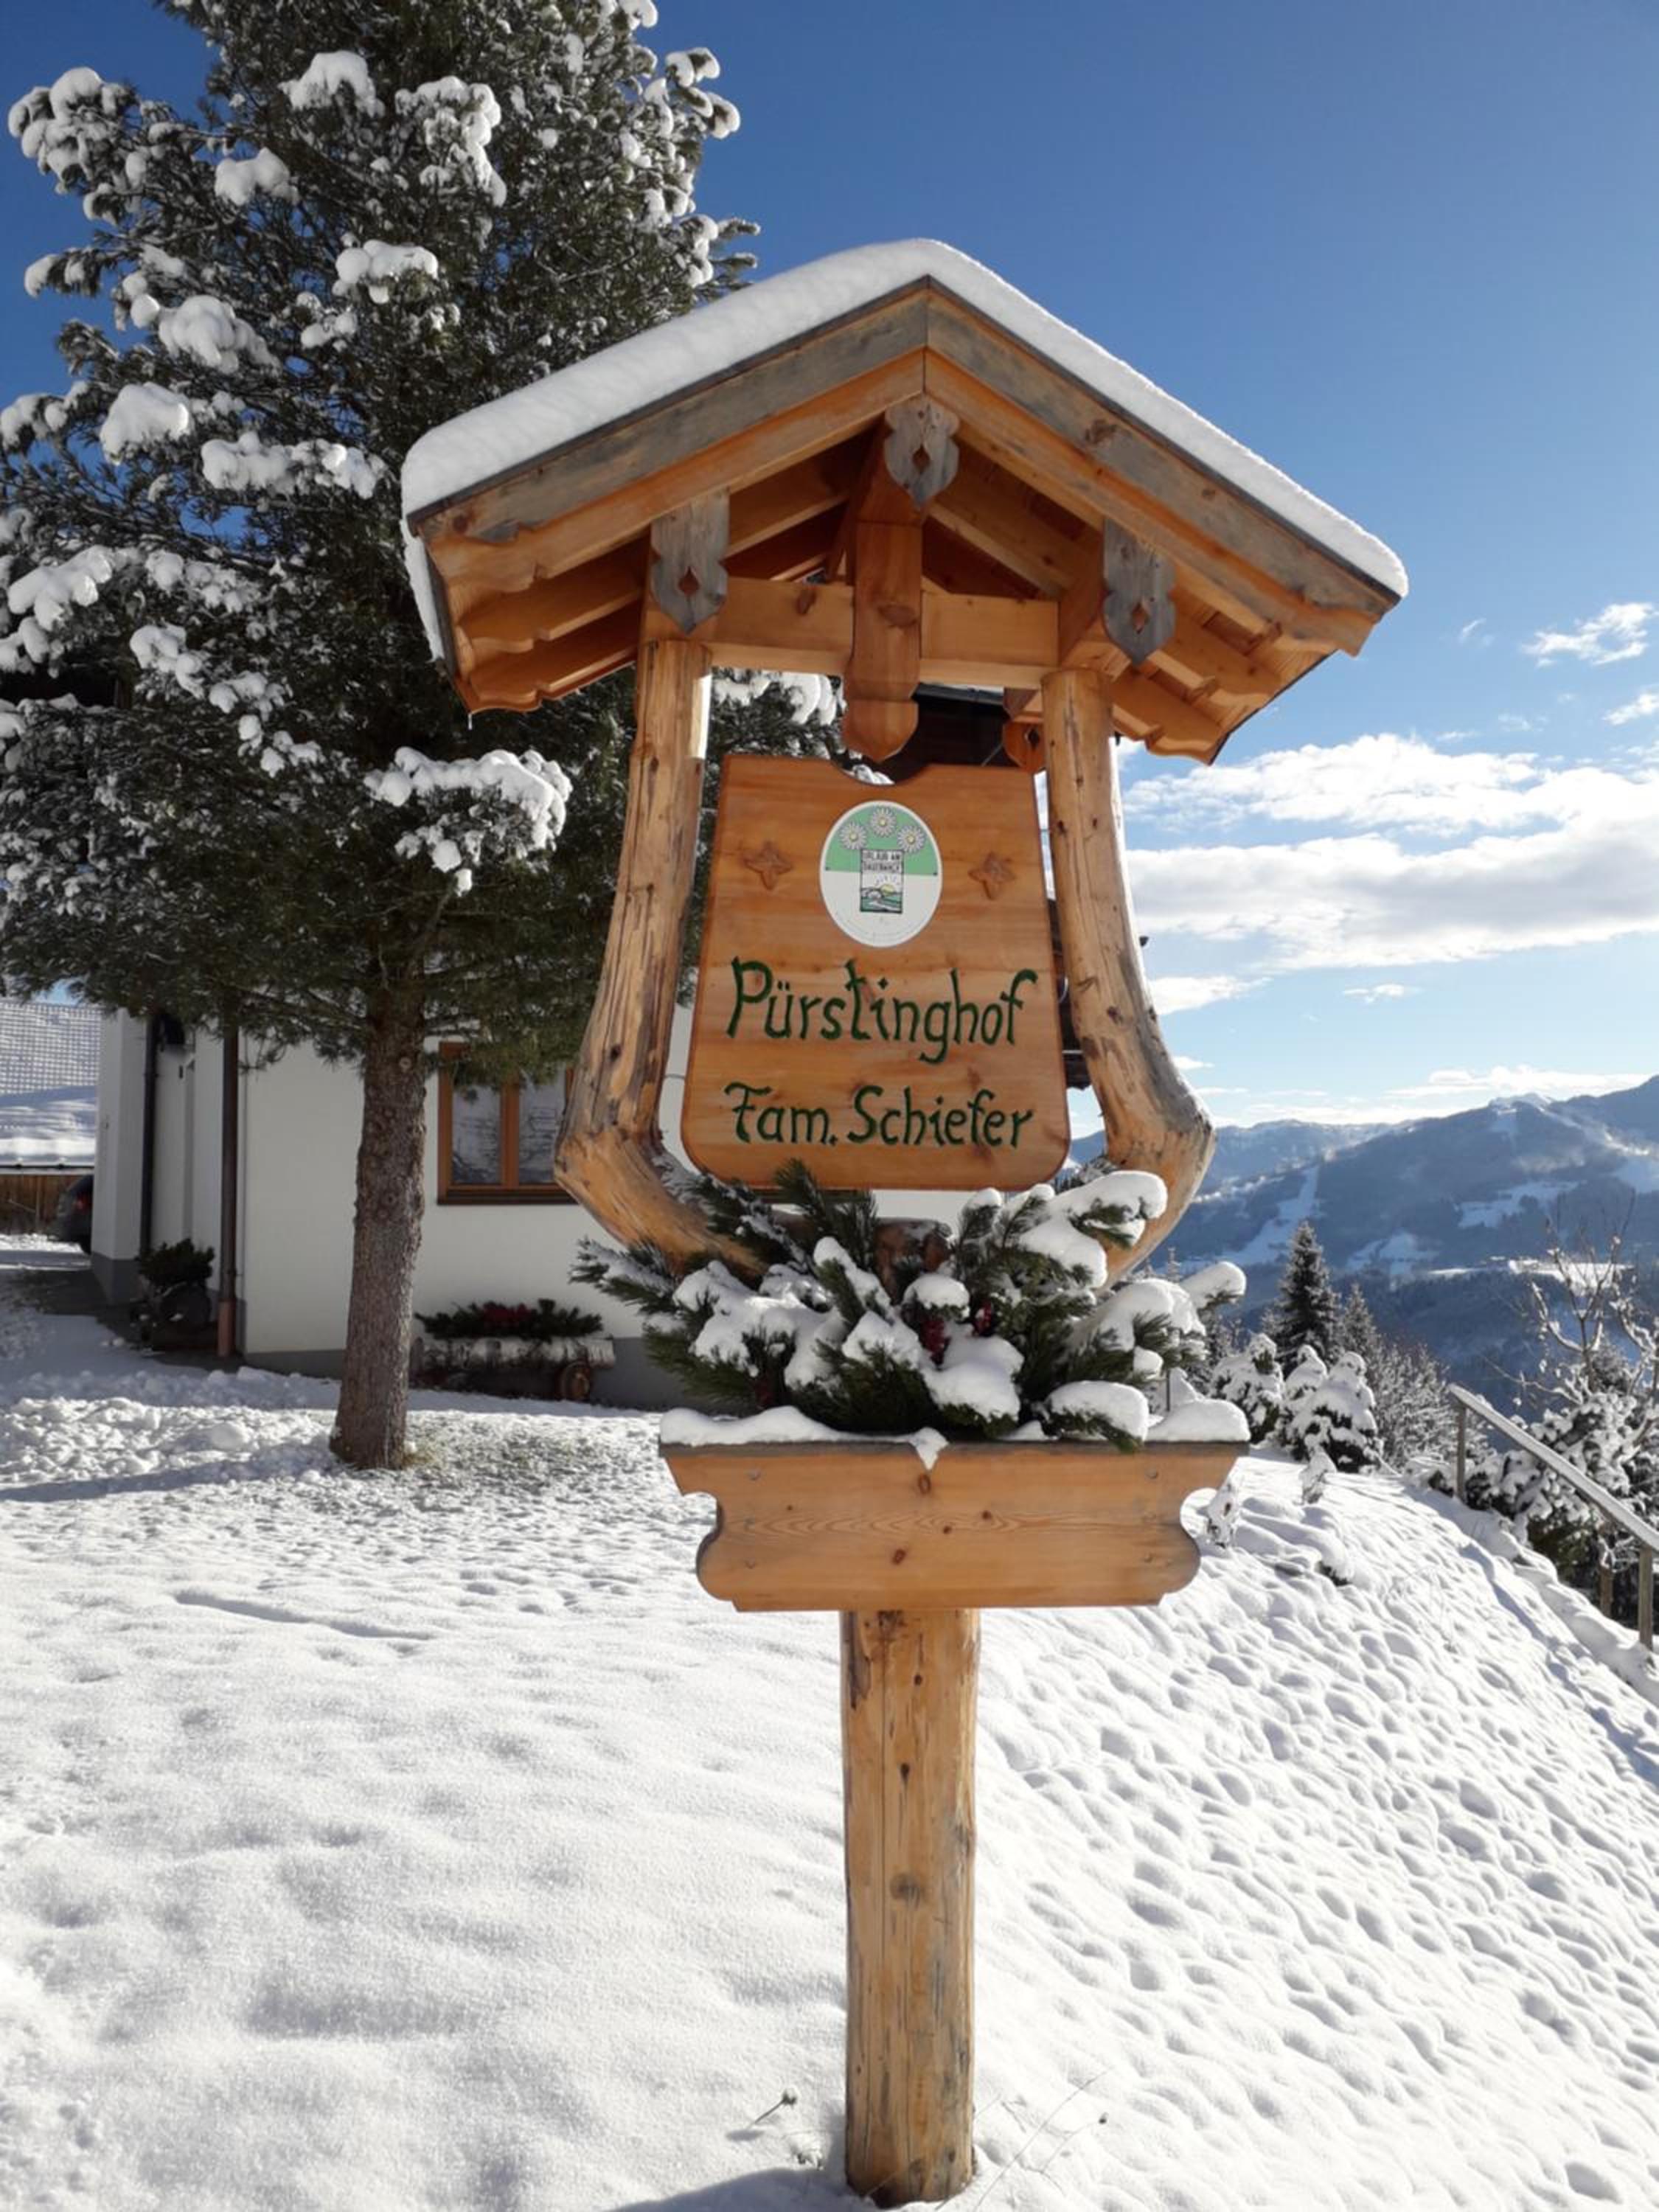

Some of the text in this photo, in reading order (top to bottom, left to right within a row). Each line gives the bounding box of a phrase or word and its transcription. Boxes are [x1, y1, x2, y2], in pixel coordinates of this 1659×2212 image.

[726, 957, 1039, 1065] Pürstinghof
[724, 1082, 1034, 1147] Fam. Schiefer
